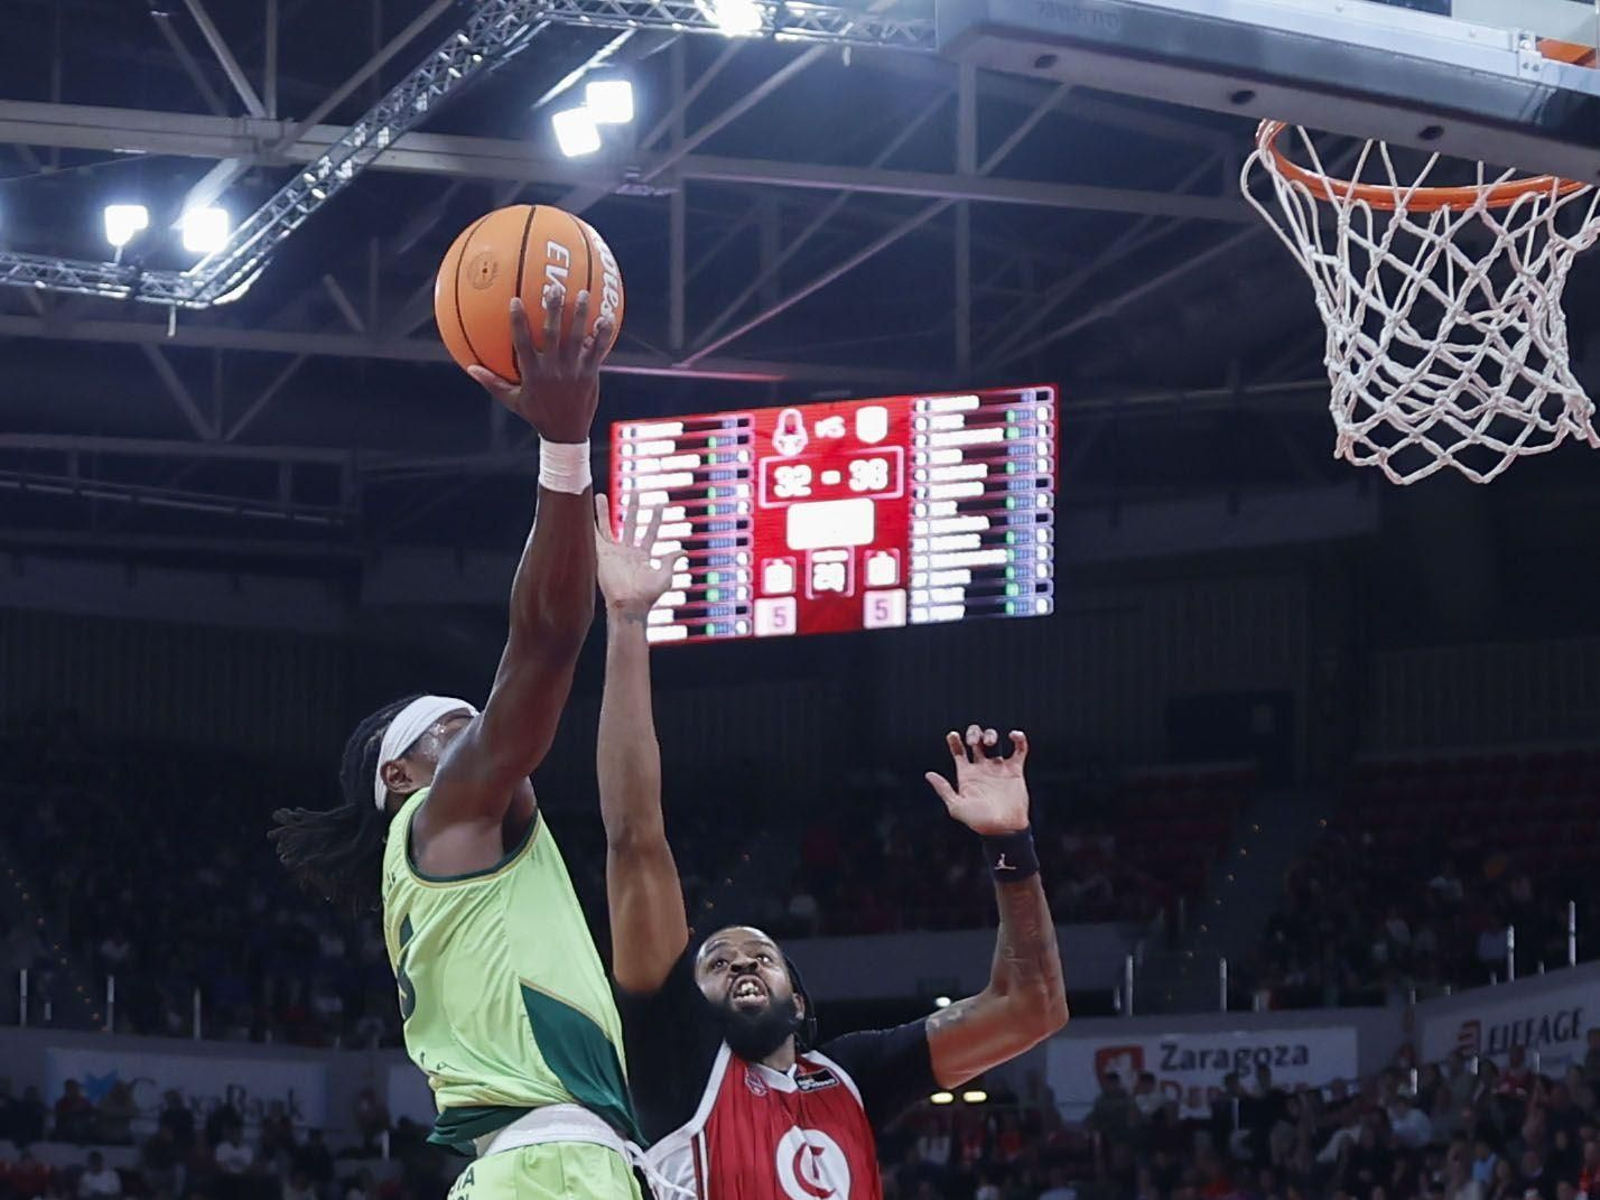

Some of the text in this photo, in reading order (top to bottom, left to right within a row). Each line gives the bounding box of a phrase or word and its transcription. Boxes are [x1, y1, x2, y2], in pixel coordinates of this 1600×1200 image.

[772, 606, 787, 628] 5
[873, 598, 889, 621] 5
[1159, 1042, 1309, 1076] Zaragoza
